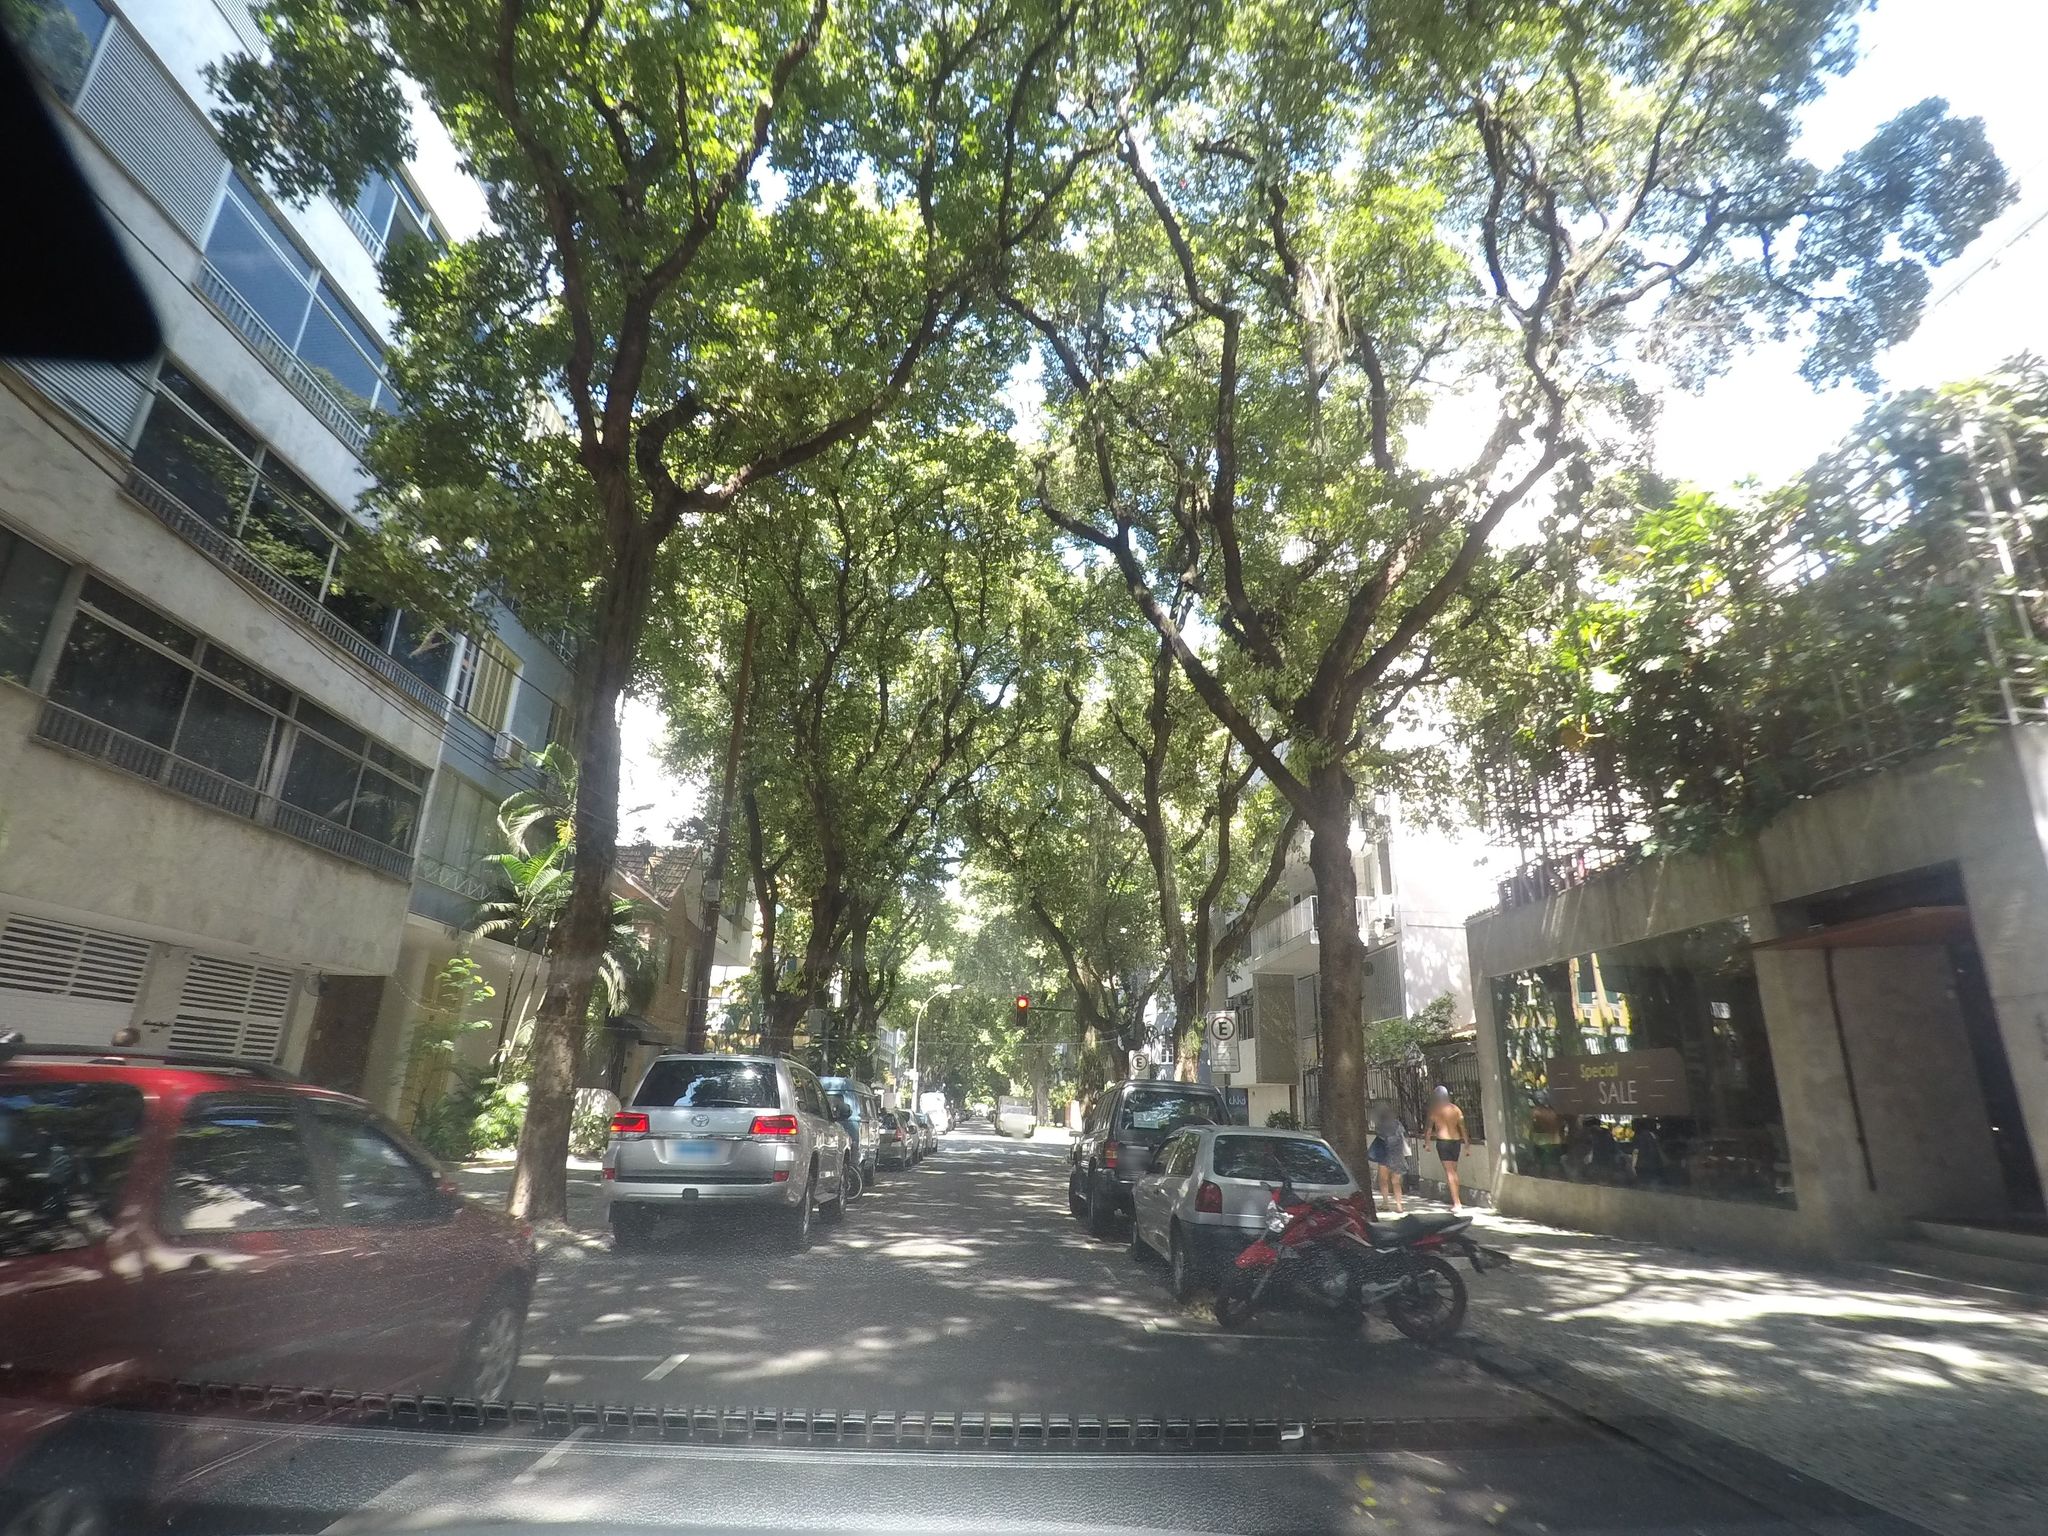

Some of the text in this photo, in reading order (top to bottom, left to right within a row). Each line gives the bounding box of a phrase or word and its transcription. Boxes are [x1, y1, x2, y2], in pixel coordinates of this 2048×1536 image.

[1218, 1021, 1228, 1036] E
[1580, 1062, 1618, 1081] Special
[1599, 1080, 1638, 1105] SALE
